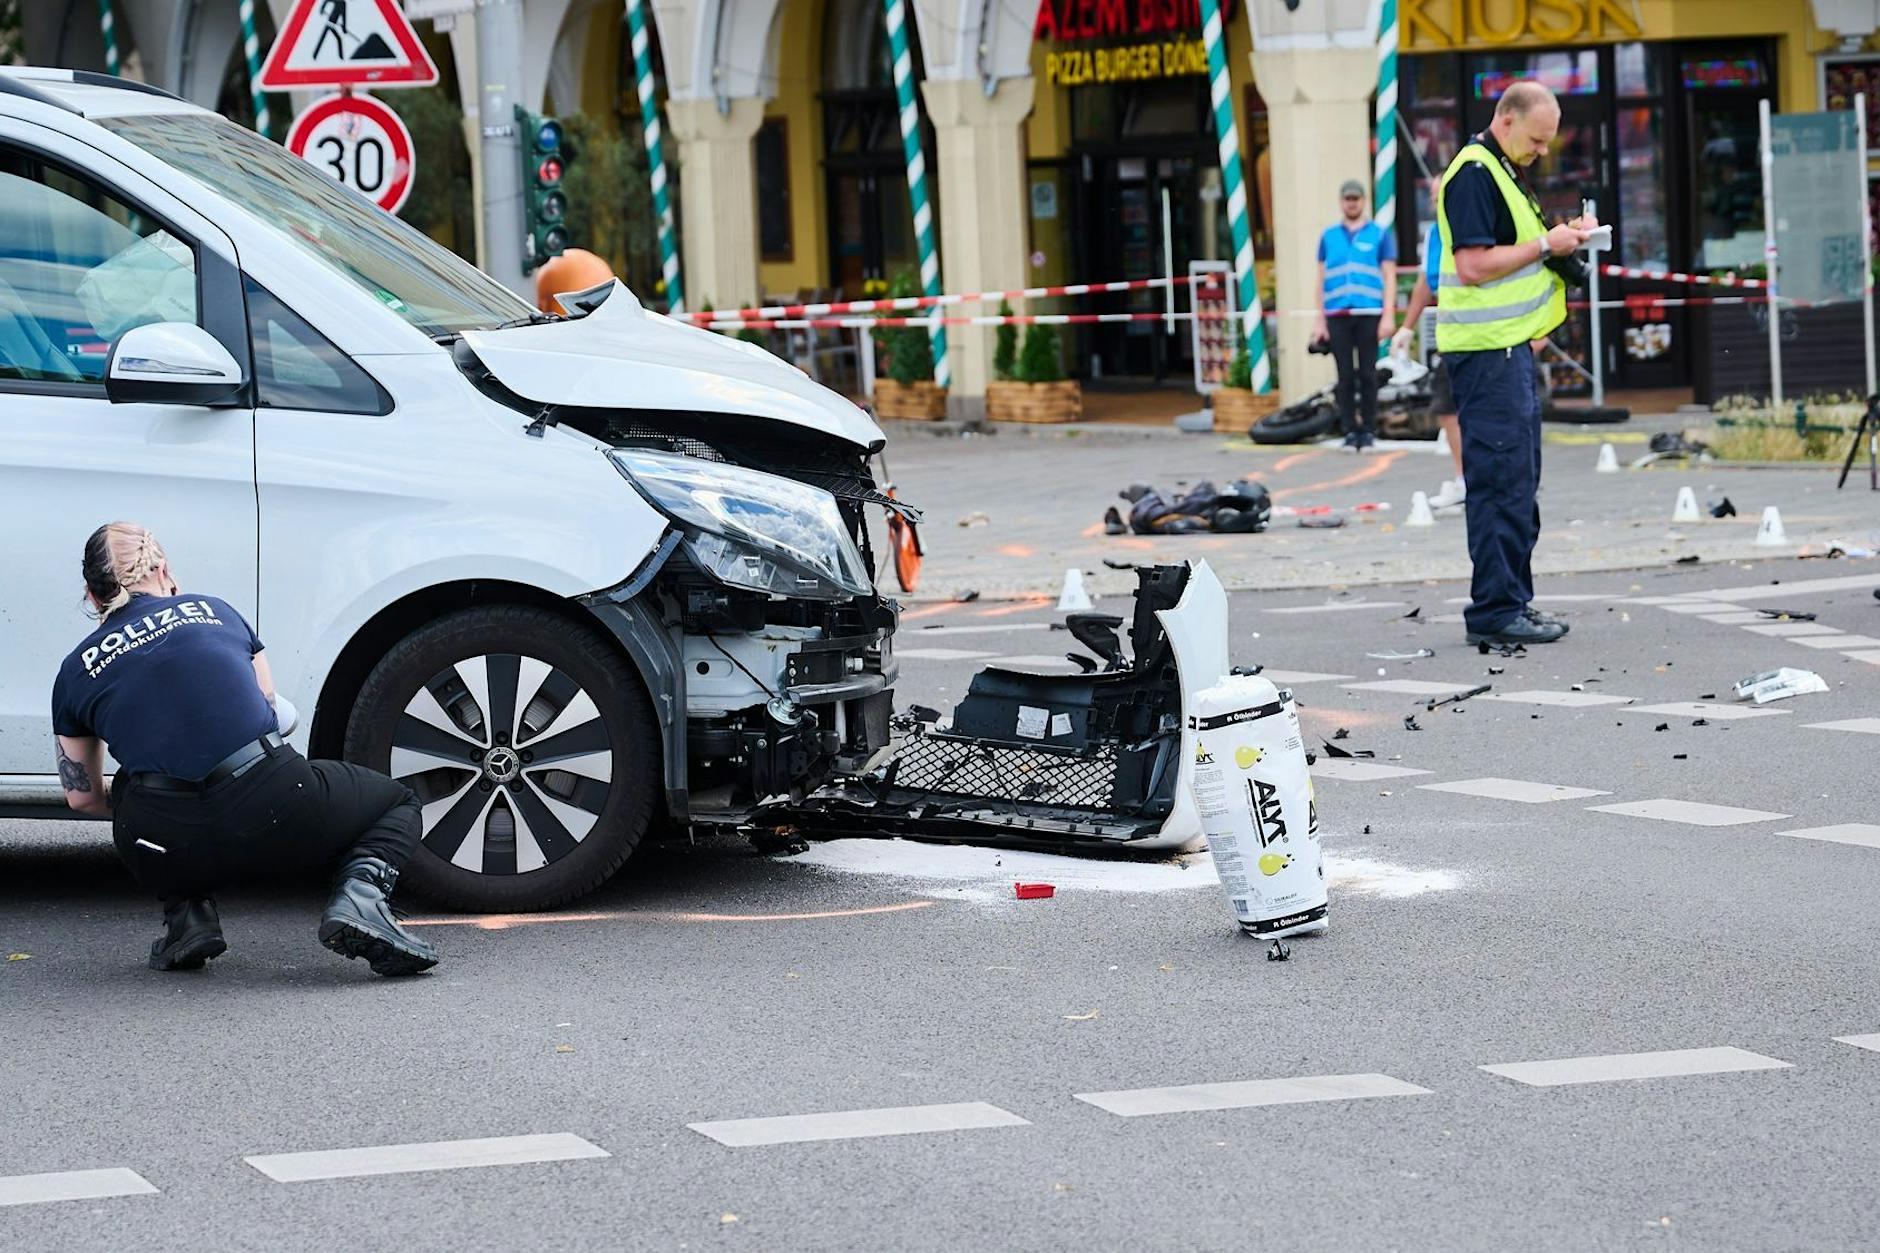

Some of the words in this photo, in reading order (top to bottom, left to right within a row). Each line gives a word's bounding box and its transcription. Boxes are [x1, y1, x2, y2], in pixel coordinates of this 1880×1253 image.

[1398, 0, 1643, 48] KIOSK
[1046, 50, 1094, 86] PIZZA
[1096, 44, 1161, 82] BURGER
[1164, 33, 1209, 77] DÖNE
[316, 136, 384, 192] 30
[81, 600, 216, 670] POLIZEI
[89, 616, 223, 679] Tatortdokumentation
[1280, 914, 1310, 927] Ölbinder
